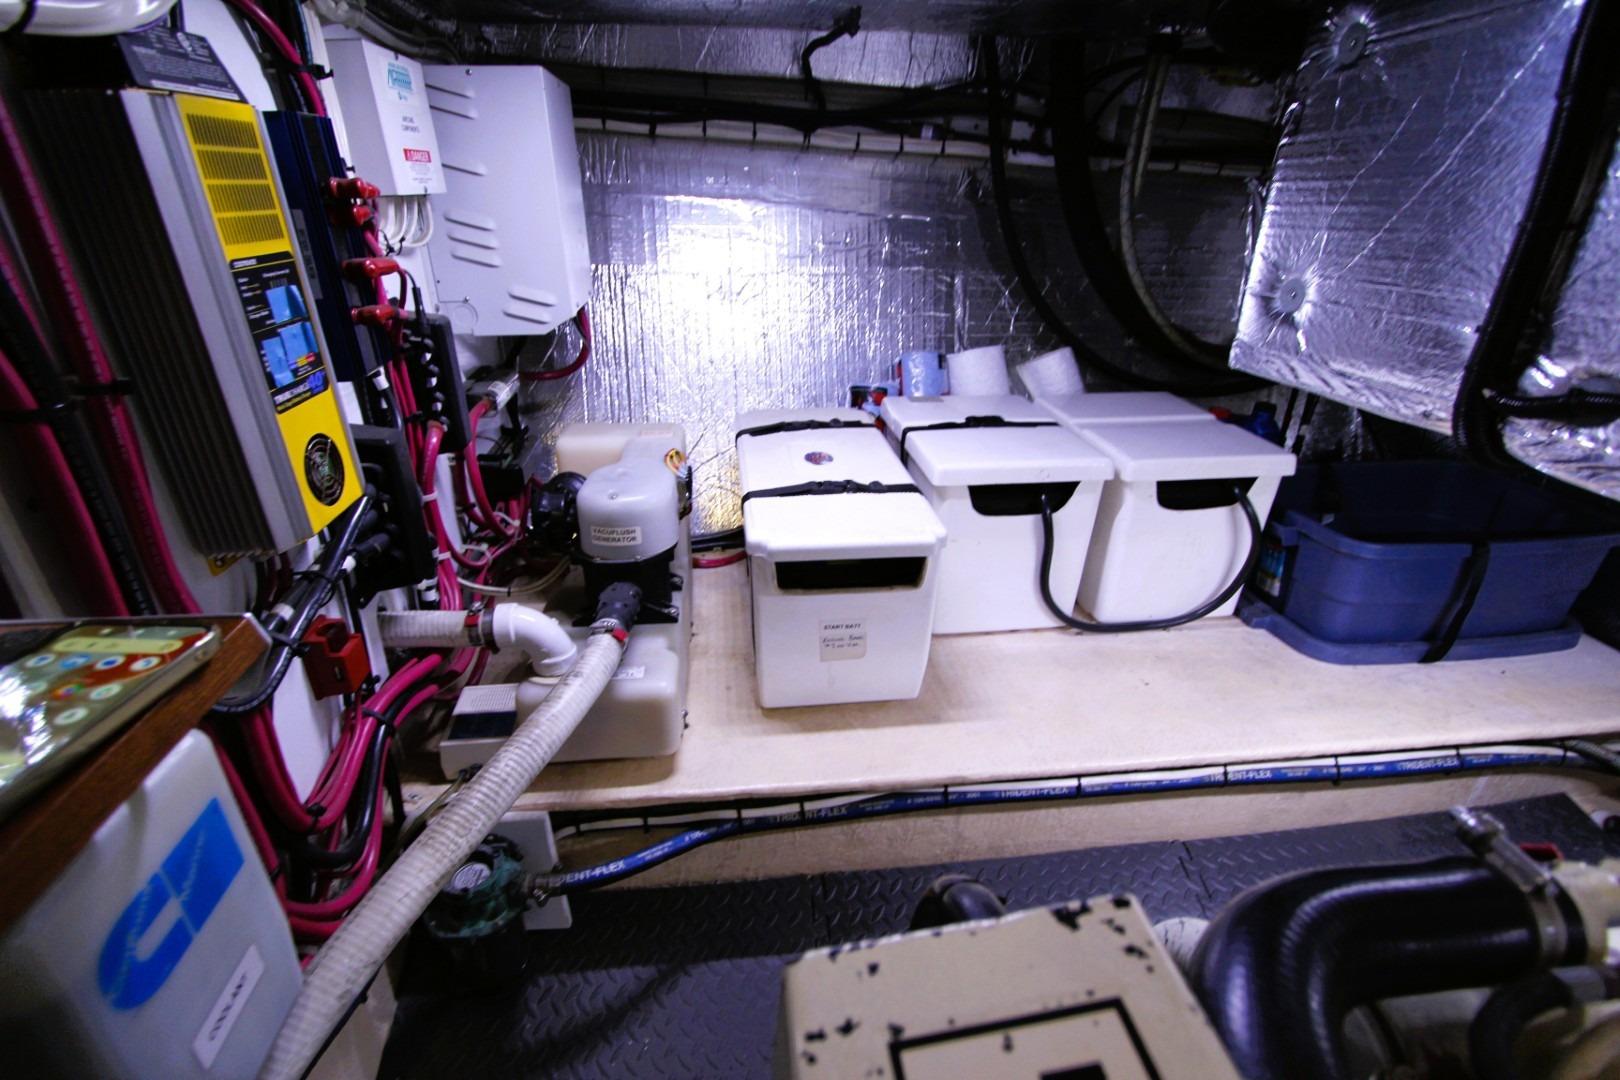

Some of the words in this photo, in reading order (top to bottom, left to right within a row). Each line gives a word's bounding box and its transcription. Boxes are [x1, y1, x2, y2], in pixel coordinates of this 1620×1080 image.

[593, 528, 636, 536] VACUFLUSH
[593, 535, 637, 543] GENERATOR
[776, 805, 848, 823] TRIDNT-FLEX
